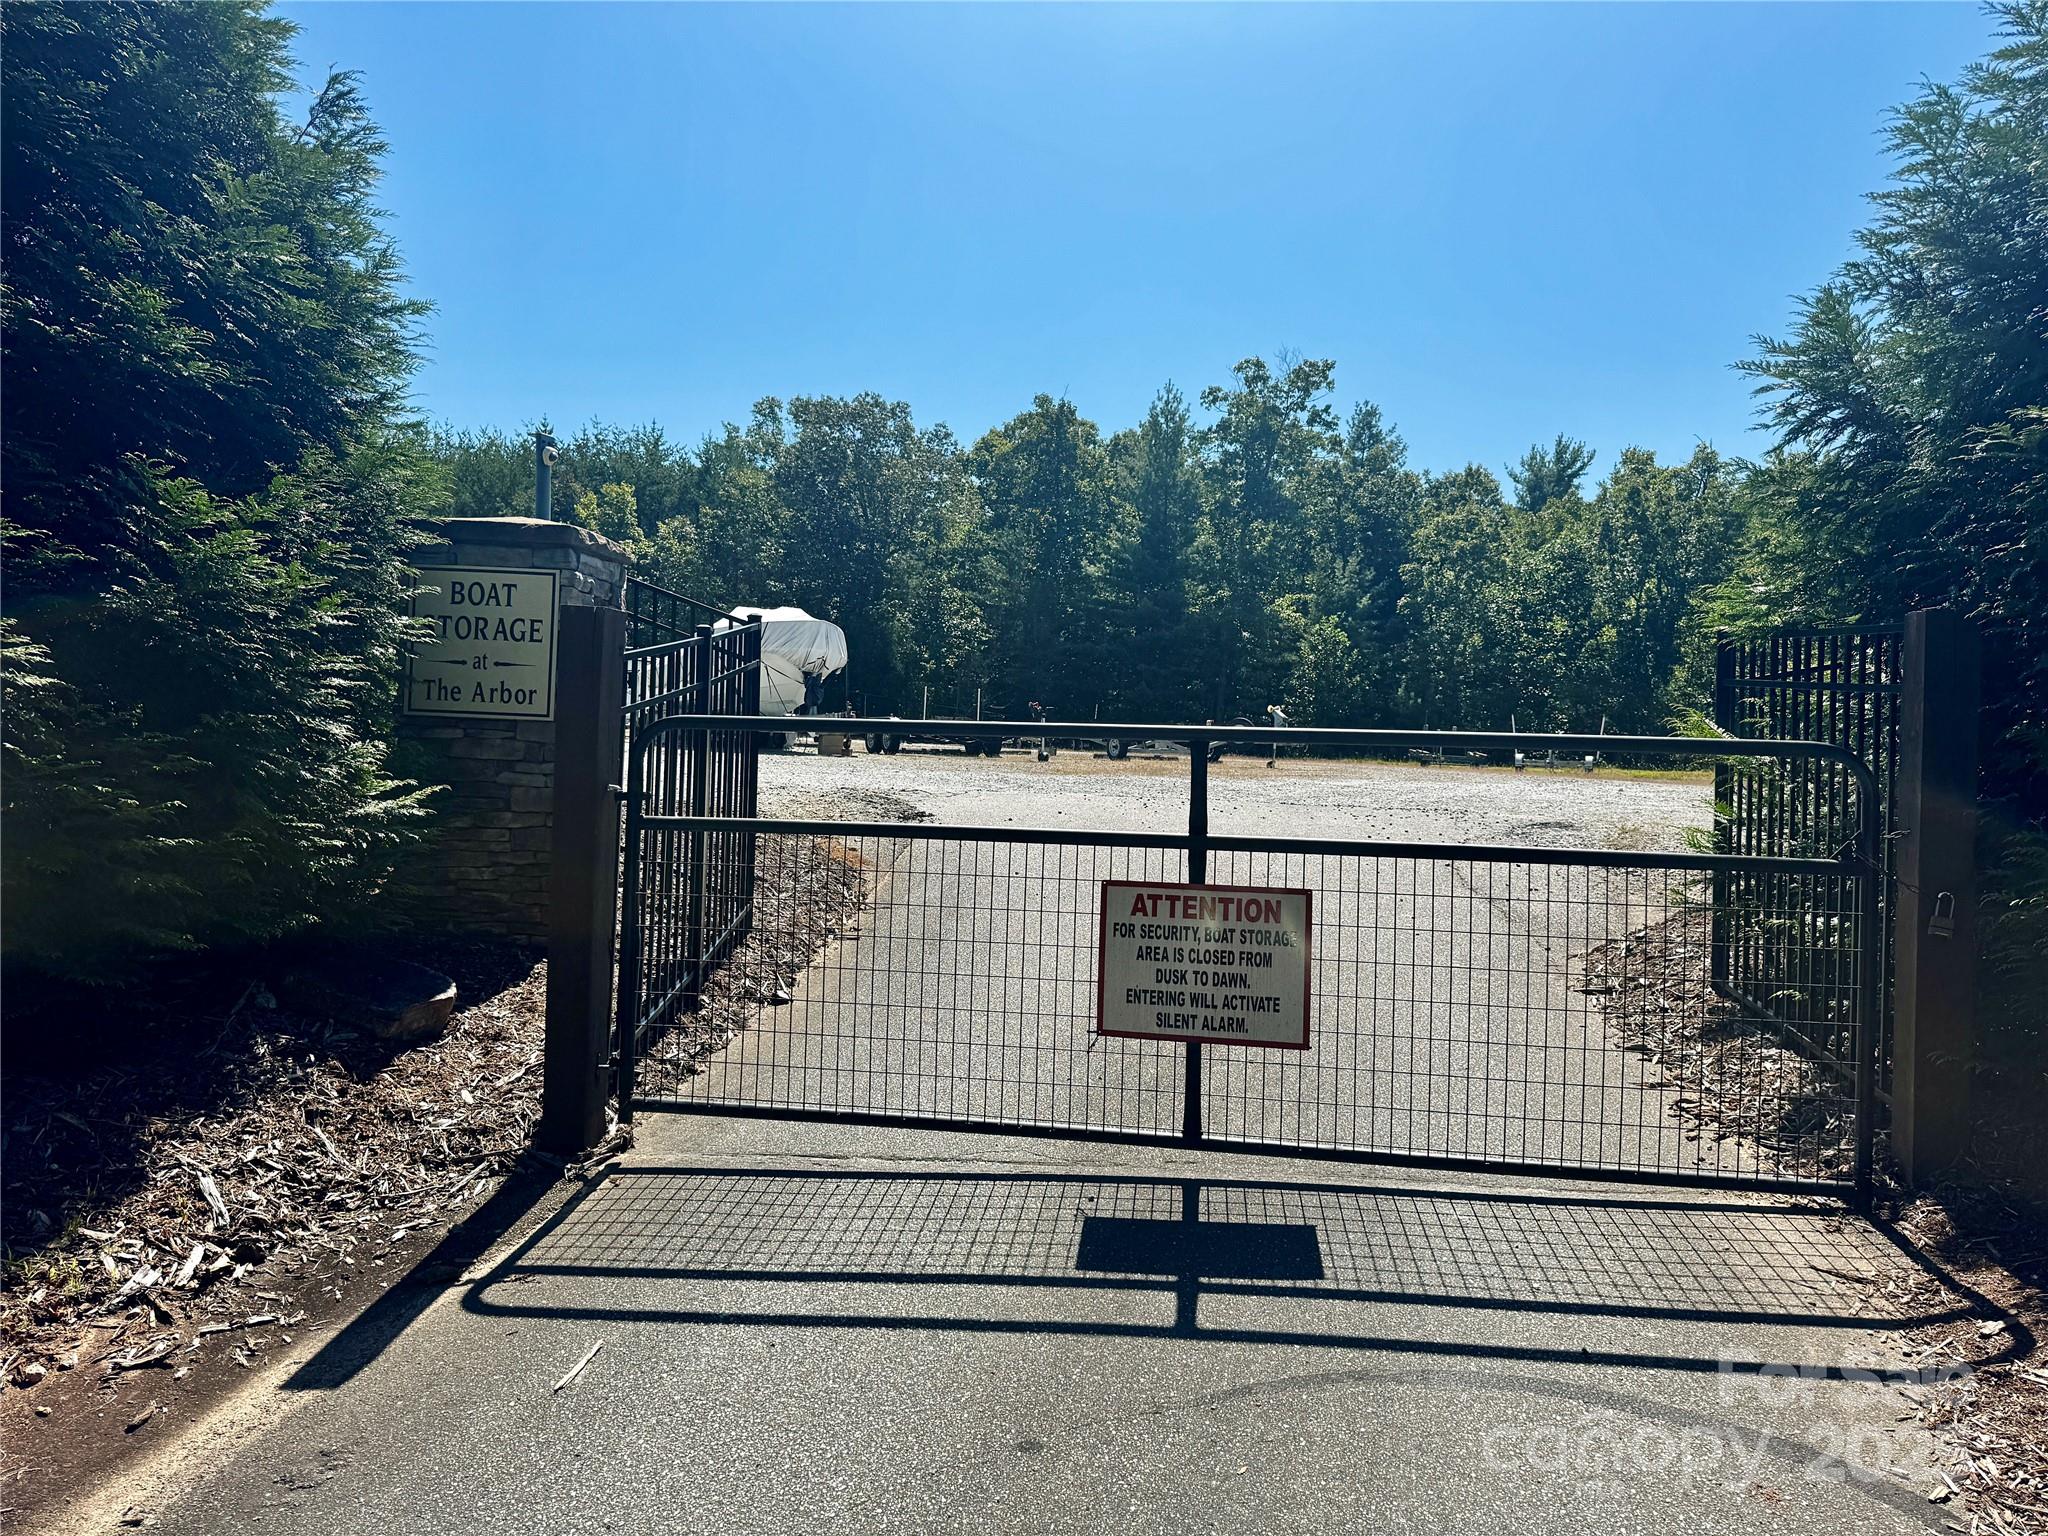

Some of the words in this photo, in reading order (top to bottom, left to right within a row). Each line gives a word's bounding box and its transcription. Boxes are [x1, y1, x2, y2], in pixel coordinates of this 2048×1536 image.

[450, 580, 518, 607] BOAT
[472, 653, 489, 671] at
[423, 678, 462, 702] The
[471, 681, 538, 705] Arbor
[1130, 893, 1282, 924] ATTENTION
[1113, 922, 1136, 939] FOR
[1139, 923, 1200, 946] SECURITY,
[1204, 926, 1236, 945] BOAT
[1239, 928, 1298, 948] STORAGE
[1136, 945, 1170, 962] AREA
[1173, 947, 1184, 963] IS
[1188, 948, 1235, 966] CLOSED
[1239, 950, 1273, 968] FROM
[1155, 968, 1188, 985] DUSK
[1192, 970, 1209, 986] TO
[1212, 971, 1251, 989] DAWN.
[1126, 988, 1186, 1007] ENTERING
[1189, 991, 1218, 1010] WILL
[1222, 994, 1281, 1013] ACTIVATE
[1156, 1012, 1198, 1030] SILENT
[1201, 1015, 1249, 1034] ALARM.
